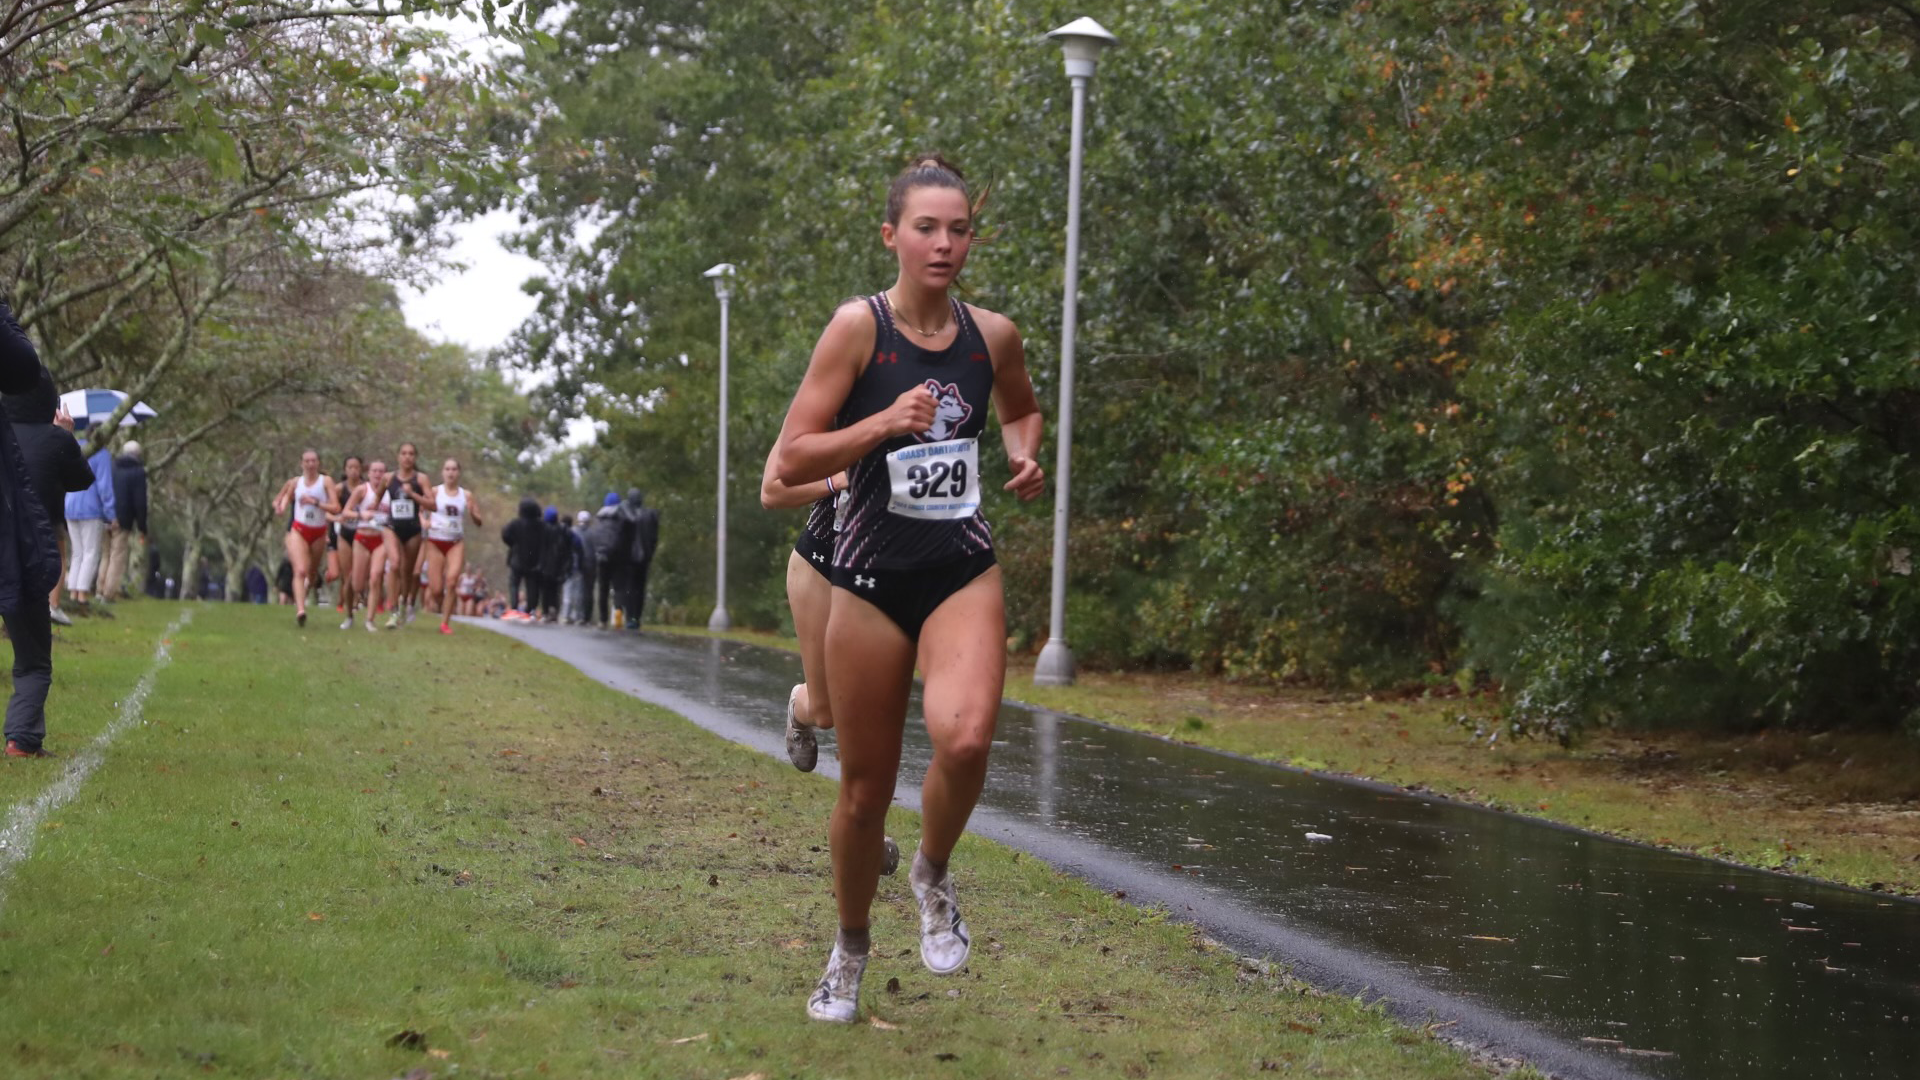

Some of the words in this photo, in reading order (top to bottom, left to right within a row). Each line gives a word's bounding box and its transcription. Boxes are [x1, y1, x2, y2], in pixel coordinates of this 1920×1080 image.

[897, 449, 926, 461] UMASS
[928, 443, 970, 456] DARTMOUTH
[907, 459, 967, 498] 329
